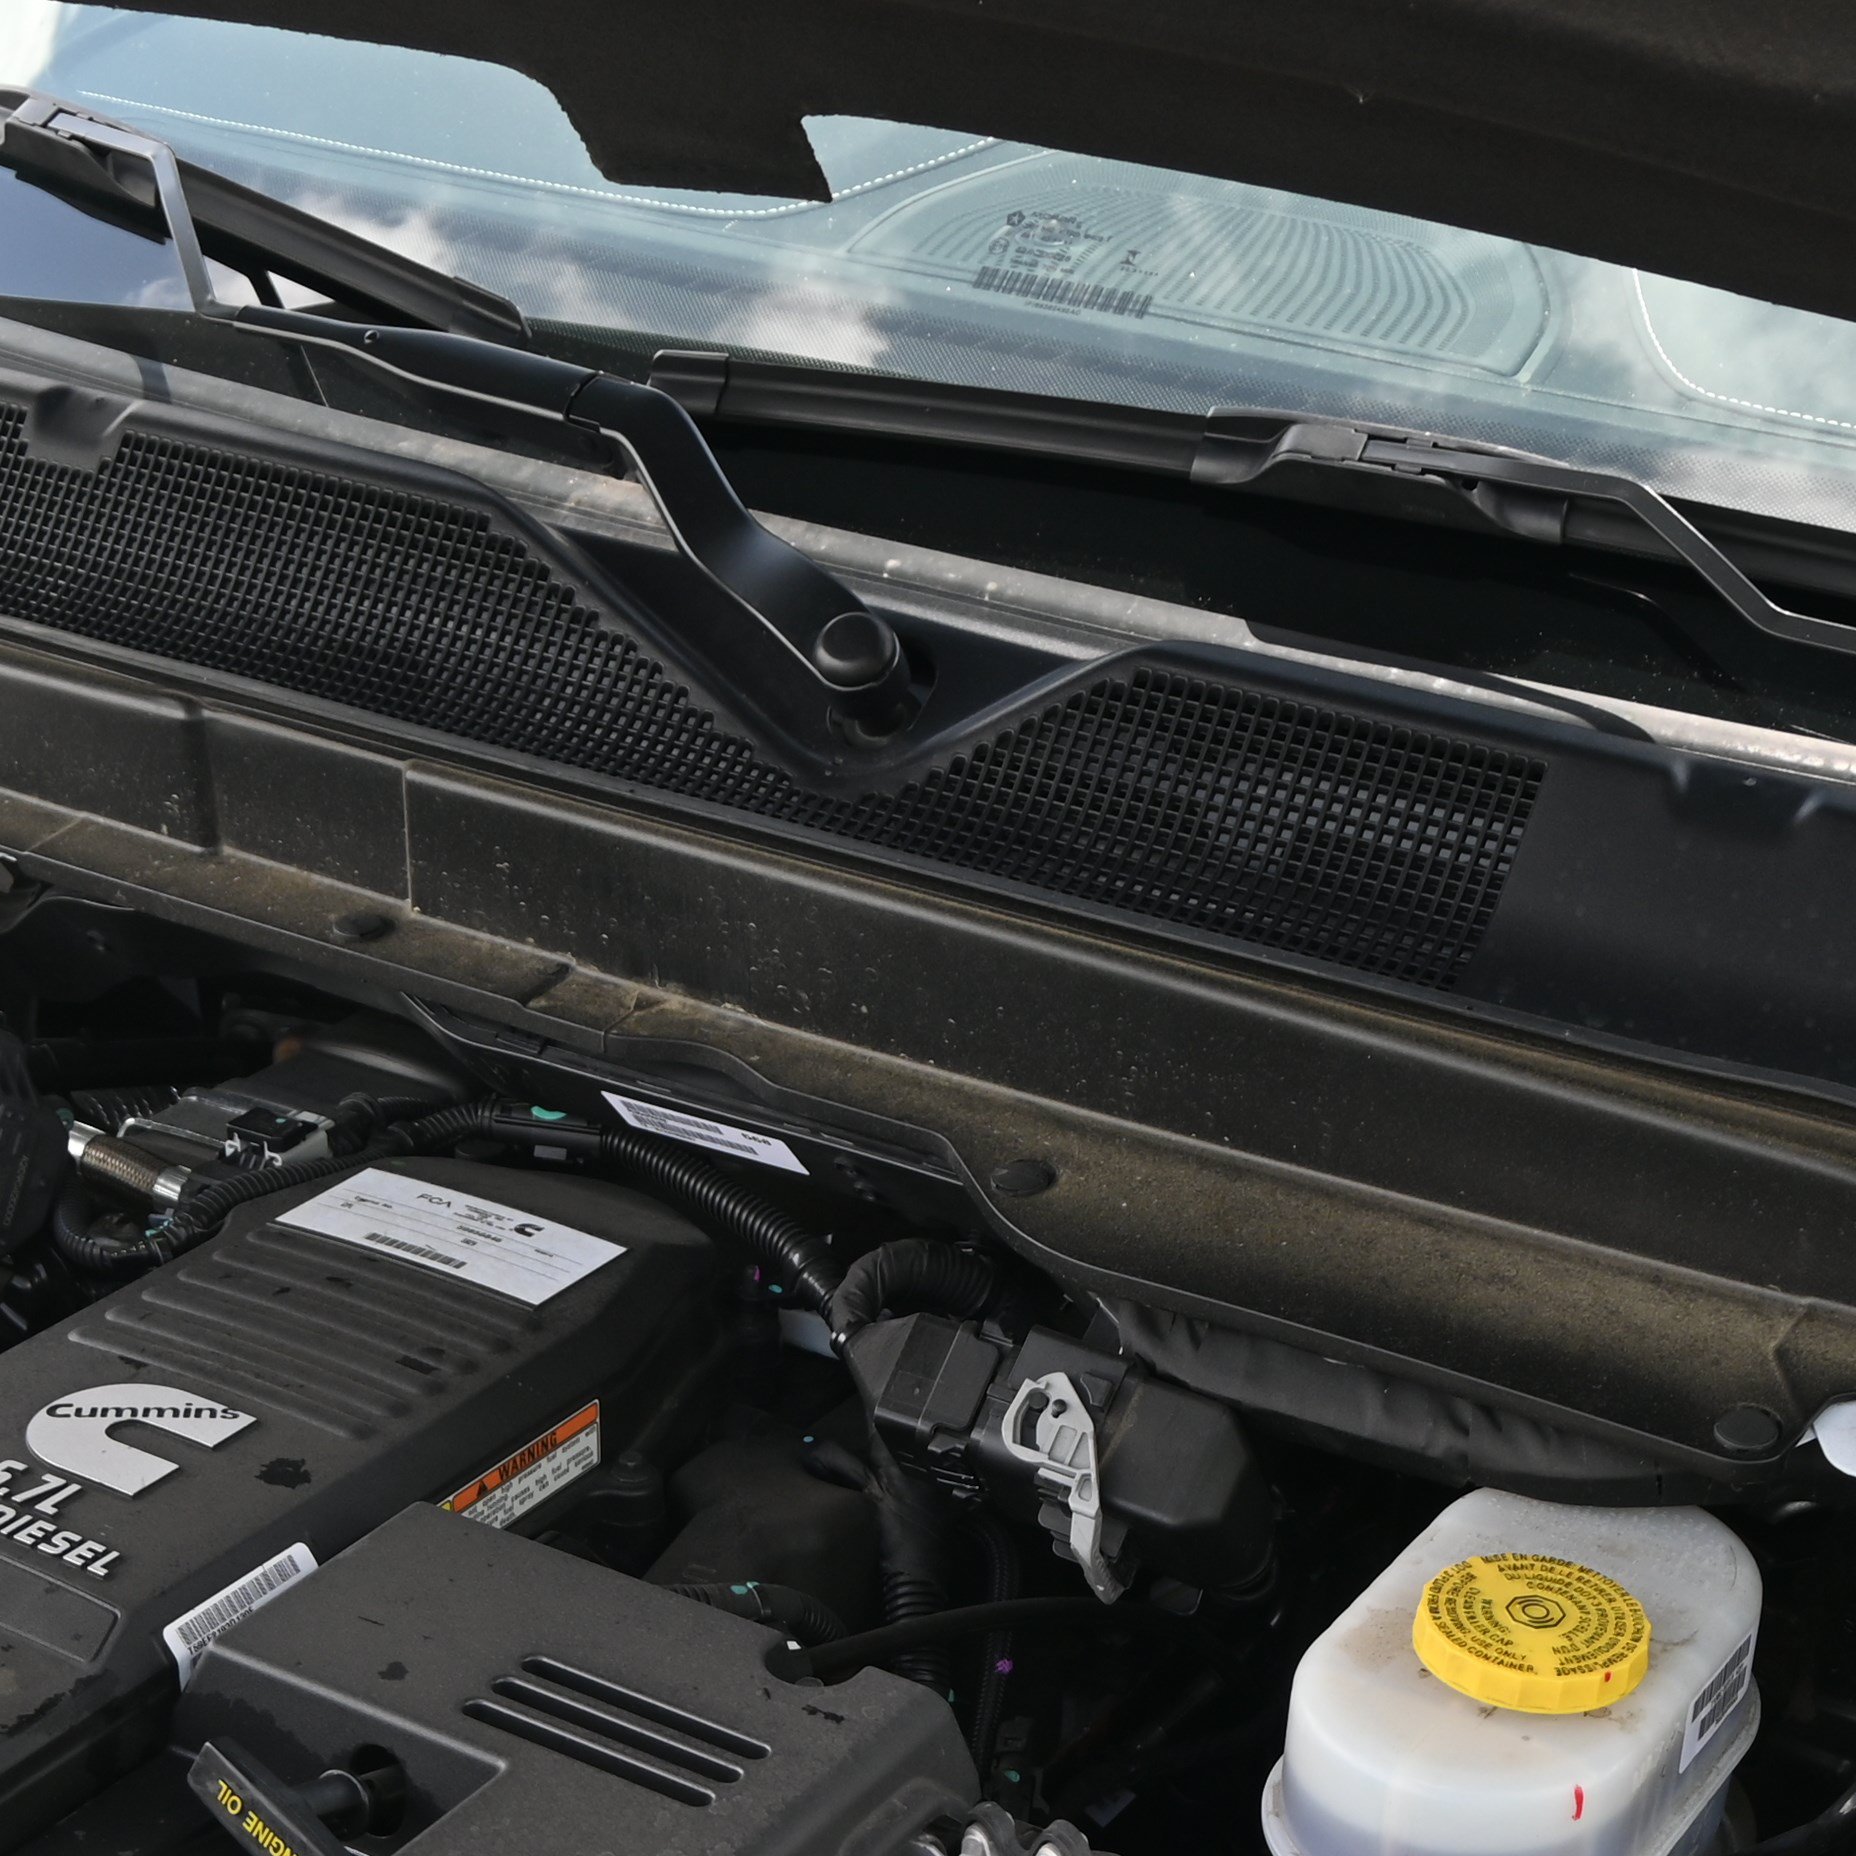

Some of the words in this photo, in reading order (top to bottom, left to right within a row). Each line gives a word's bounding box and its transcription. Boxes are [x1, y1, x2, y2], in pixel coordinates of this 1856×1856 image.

[416, 1192, 452, 1209] FCA
[45, 1402, 241, 1420] Cummins
[498, 1431, 557, 1481] WARNING
[216, 1778, 244, 1817] OIL
